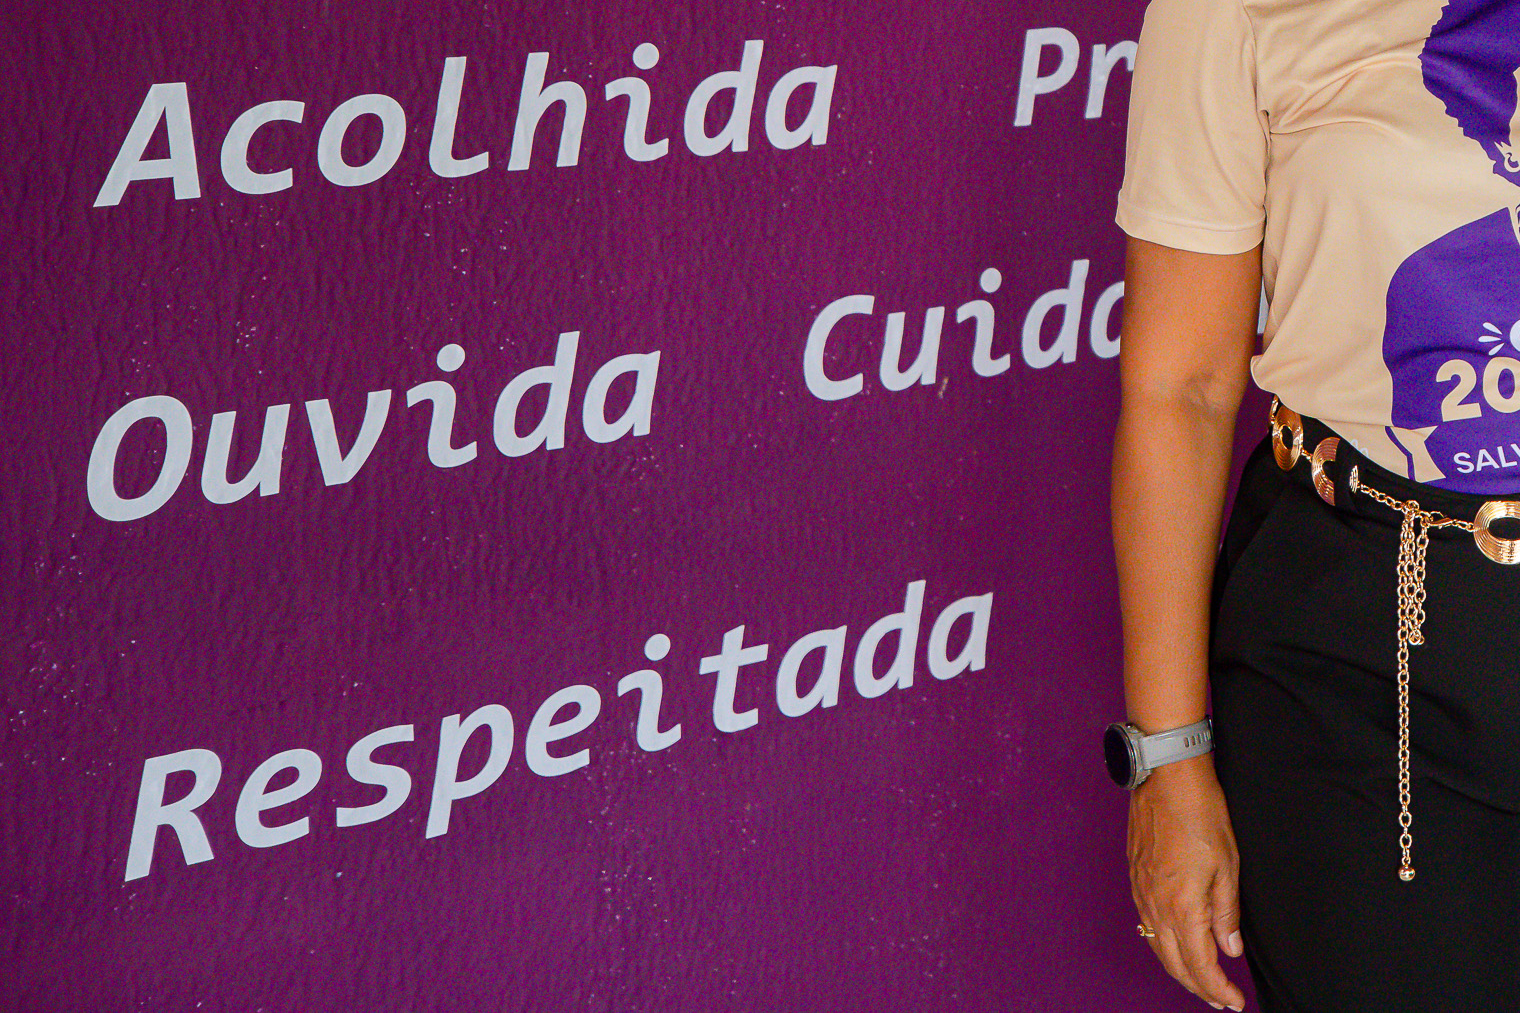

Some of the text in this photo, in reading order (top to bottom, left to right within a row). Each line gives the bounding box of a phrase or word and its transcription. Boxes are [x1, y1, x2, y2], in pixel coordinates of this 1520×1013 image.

[93, 27, 1139, 207] Acolhida Pr
[86, 331, 660, 522] Ouvida
[124, 579, 994, 882] Respeitada
